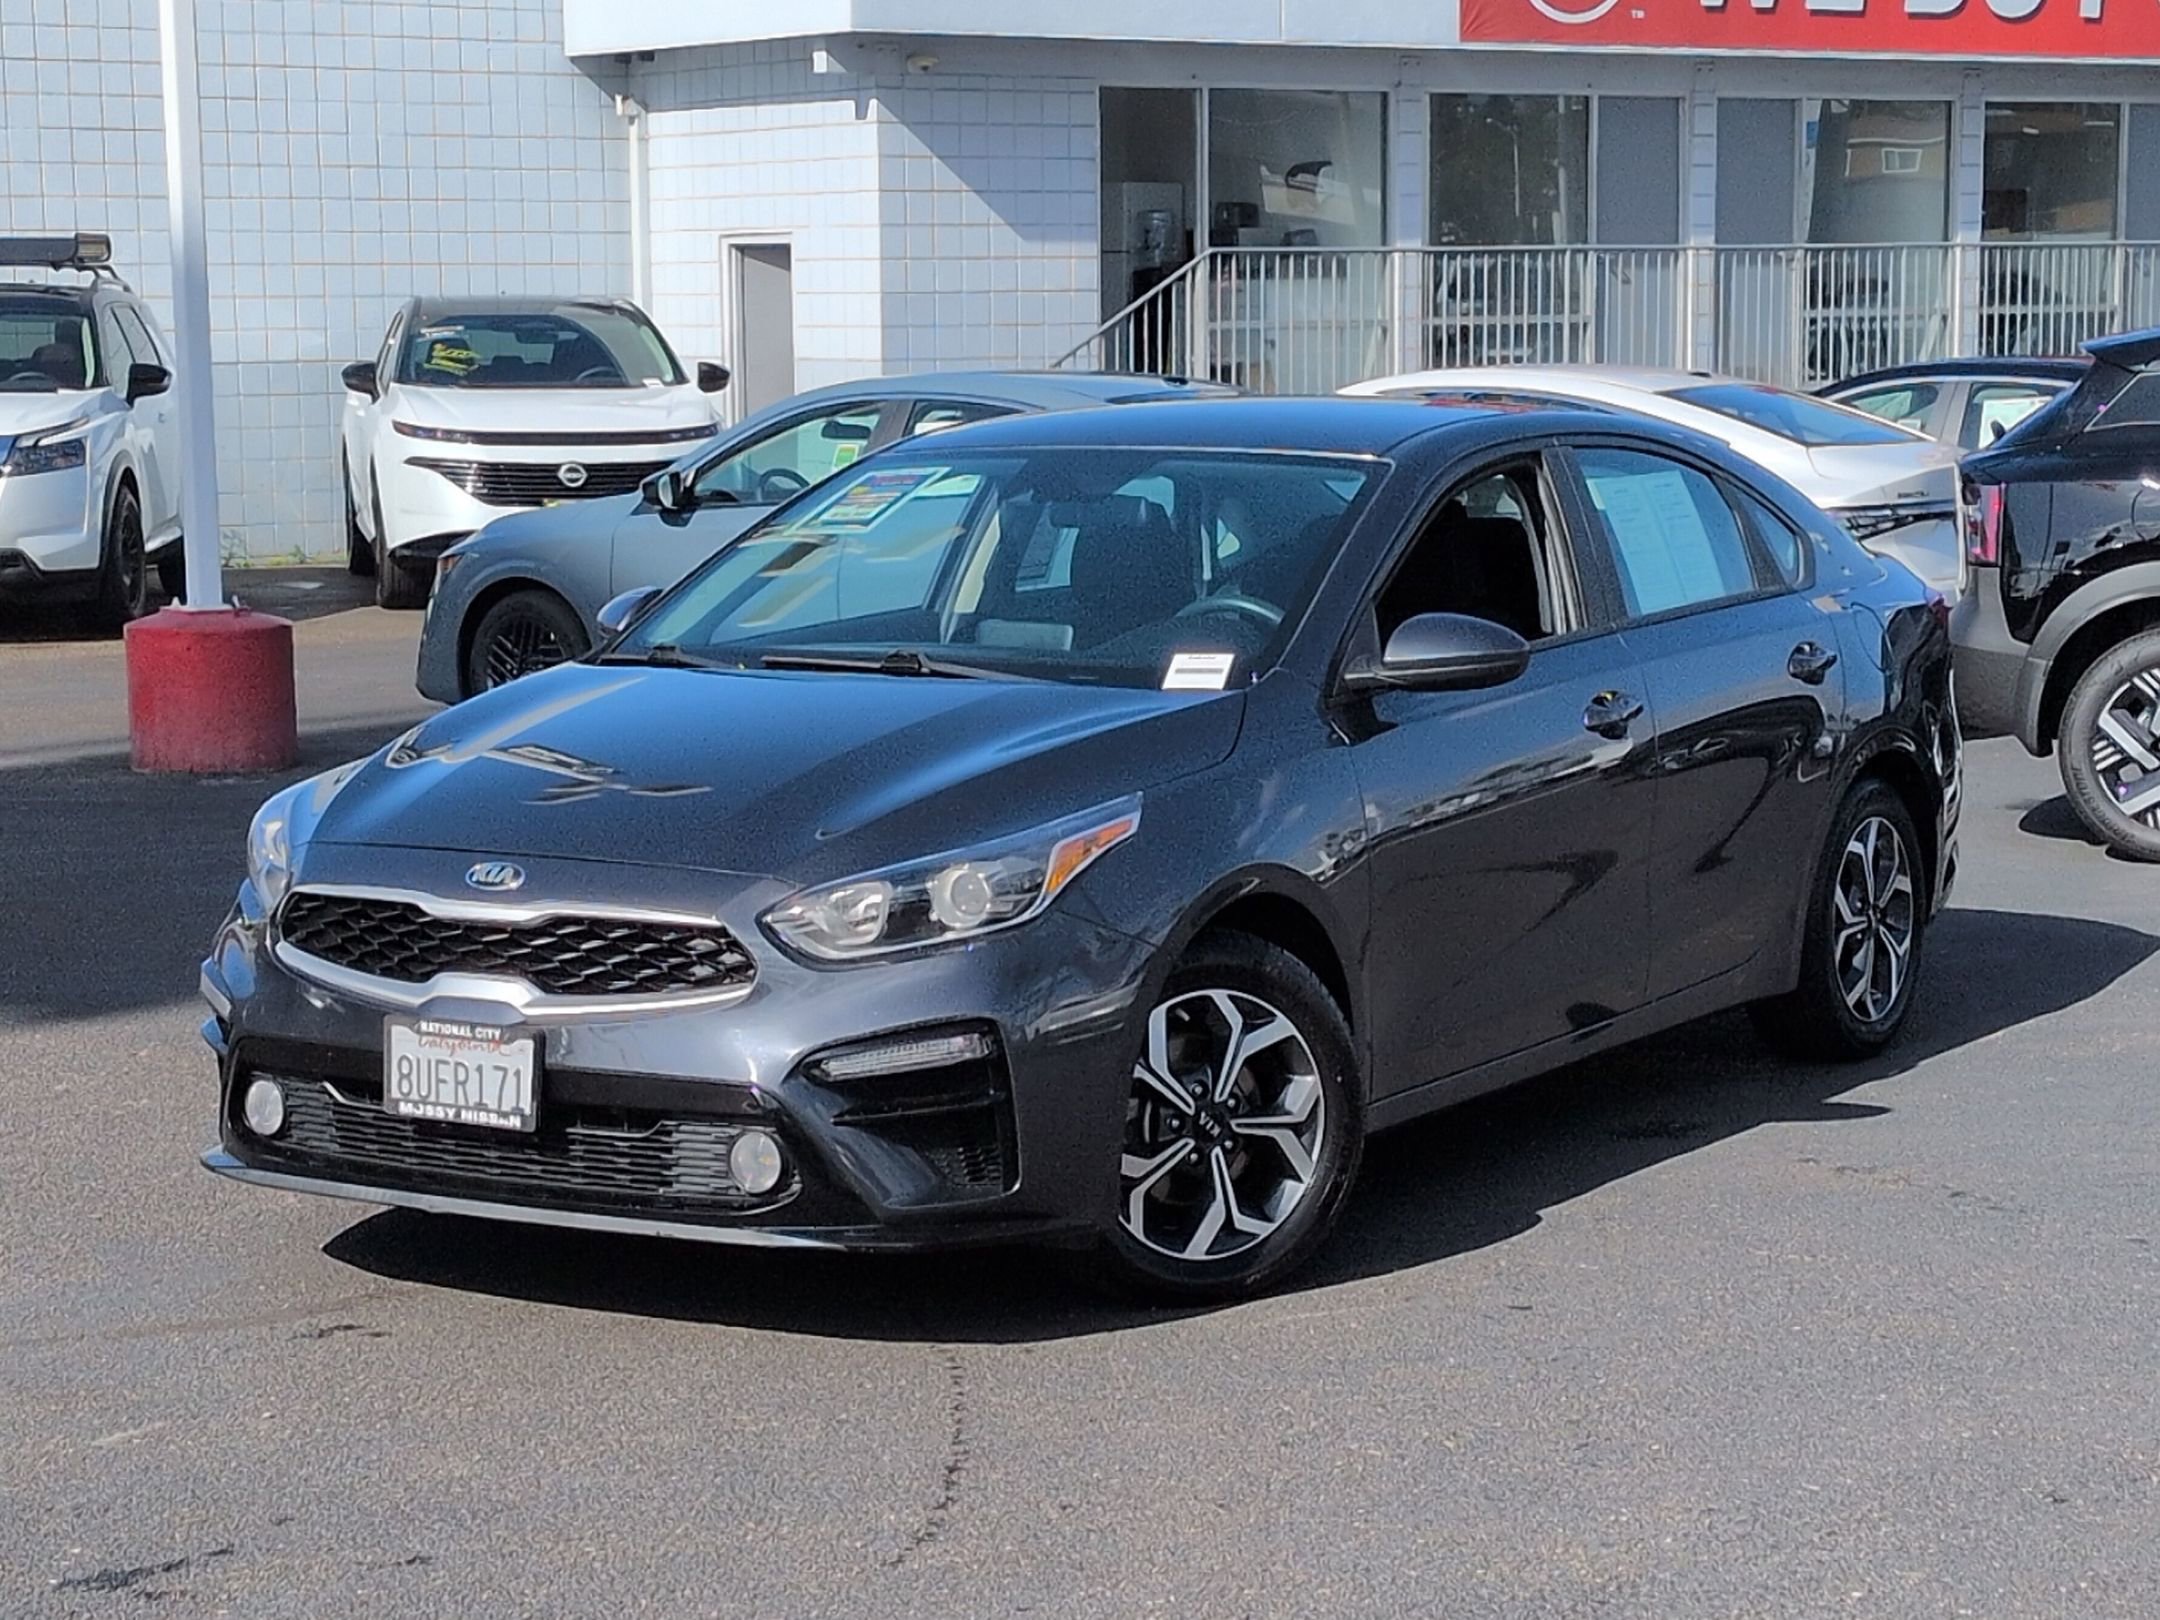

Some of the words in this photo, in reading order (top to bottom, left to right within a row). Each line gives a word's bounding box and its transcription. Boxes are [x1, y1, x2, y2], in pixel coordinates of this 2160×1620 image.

[420, 1020, 473, 1037] NATIONAL
[474, 1026, 502, 1042] CITY
[397, 1055, 524, 1115] 8UFR171
[398, 1101, 456, 1120] MOSSY
